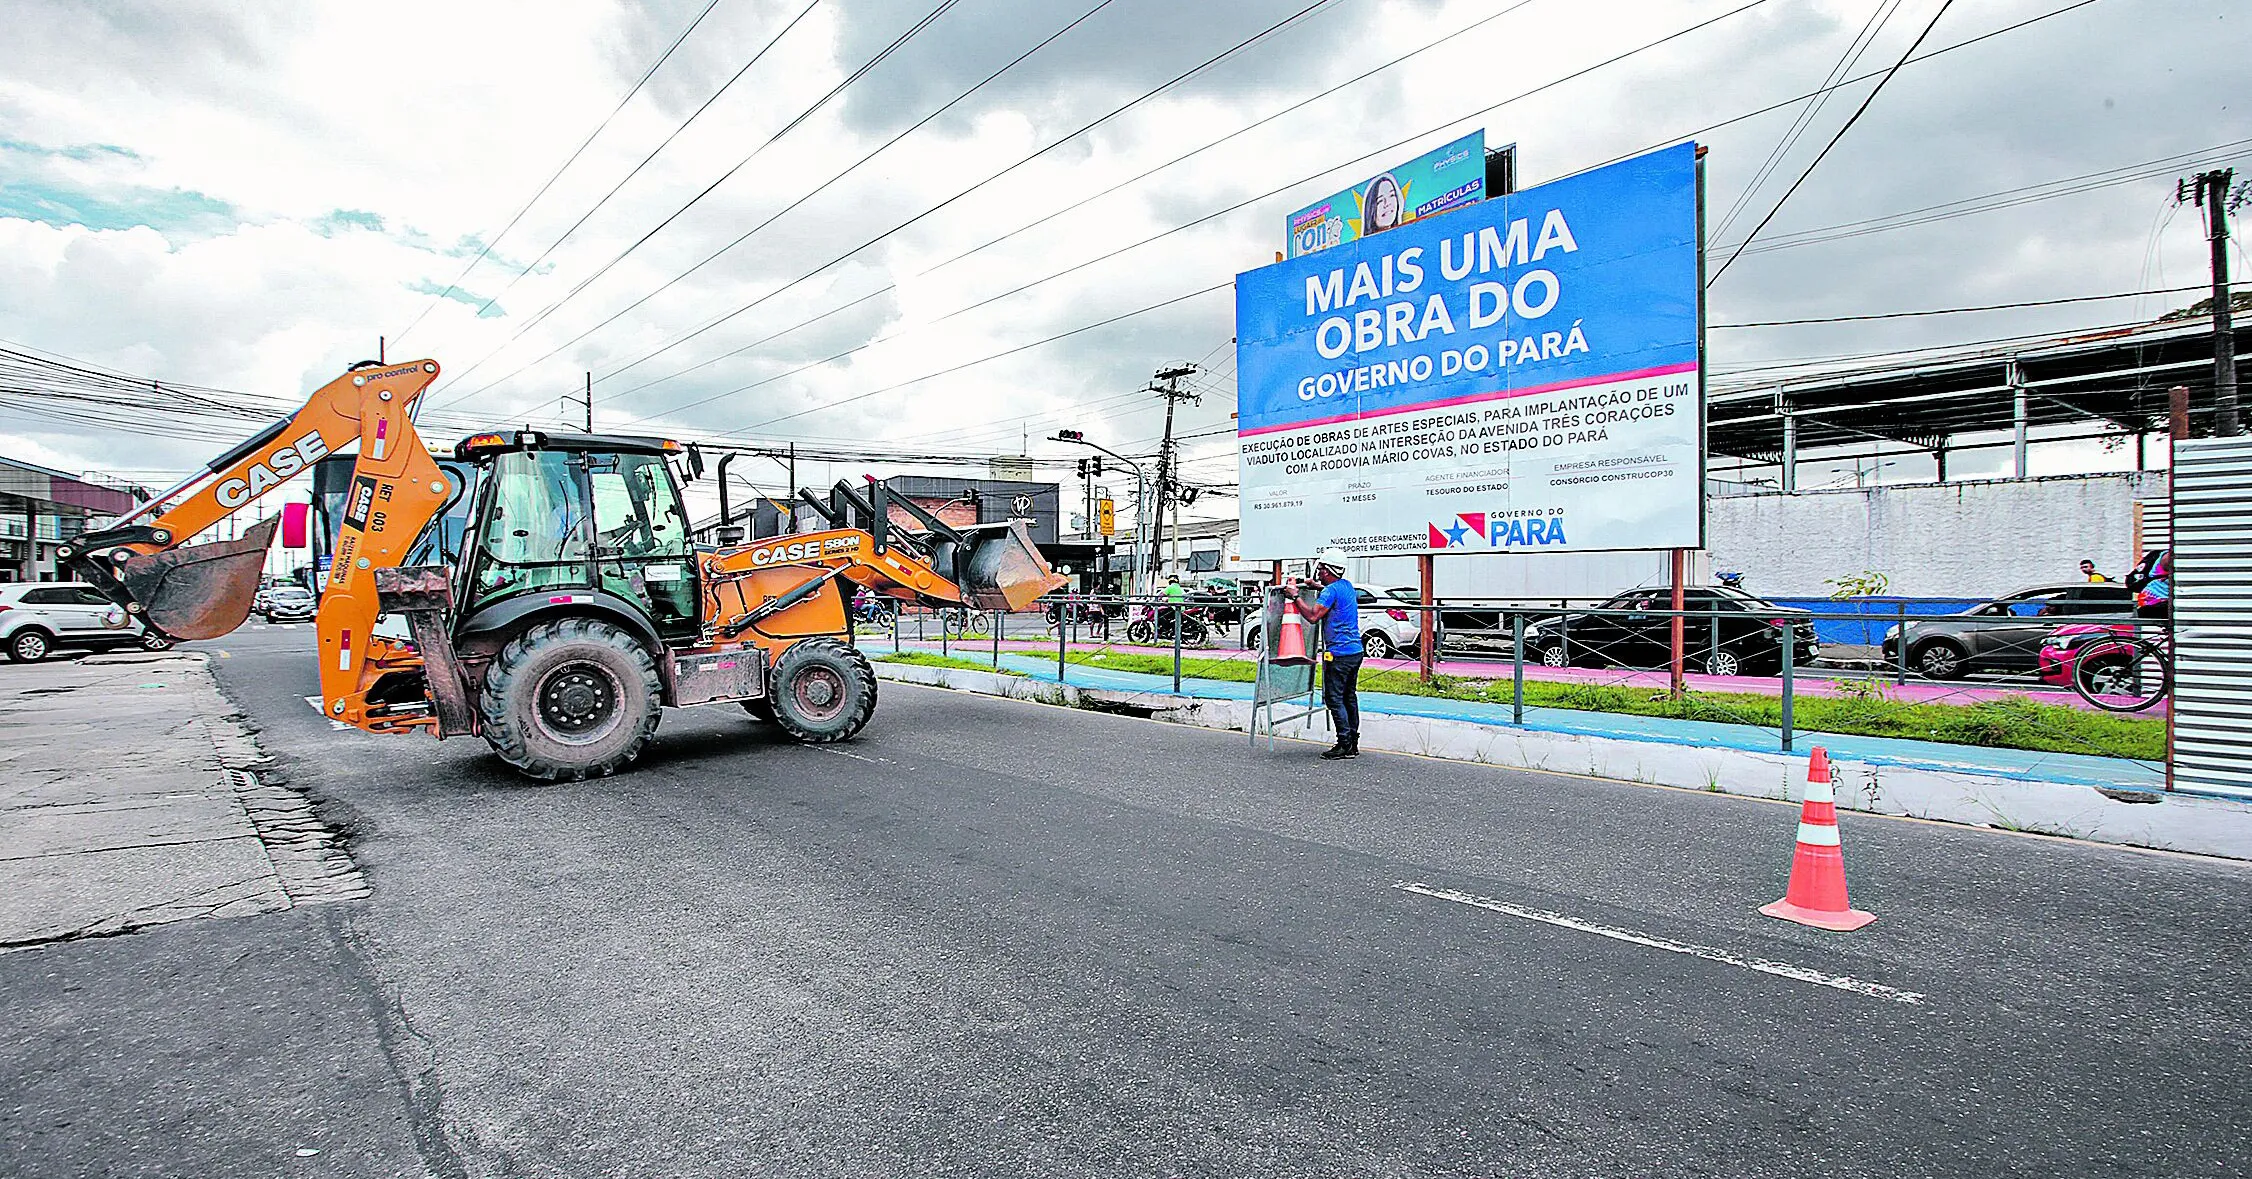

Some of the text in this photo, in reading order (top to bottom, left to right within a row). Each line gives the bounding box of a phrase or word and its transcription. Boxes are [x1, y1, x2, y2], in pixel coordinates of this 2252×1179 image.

[1305, 208, 1579, 316] MAIS UMA
[1315, 269, 1560, 360] OBRA DO
[1297, 318, 1590, 402] GOVERNO DO PARÁ
[366, 365, 418, 383] pro control
[1242, 383, 1689, 454] EXECUÇÃO DE OBRAS DE ARTES ESPECIAIS, PARA IMPLANTAÇÃO DE UM
[1246, 403, 1675, 467] VIADUTO LOCALIZADO NA INTERSEÇÃO DA AVENIDA TRÊS CORAÇÕES
[1285, 426, 1609, 475] COM A RODOVIA MÁRIO COVAS, NO ESTADO DO PARÁ
[215, 429, 329, 508] CASE
[1554, 454, 1668, 472] EMPRESA RESPONSÁVEL
[1425, 468, 1509, 482] AGENTE FINANCIADOR
[1550, 469, 1674, 487] CONSÓRCIO CONSTRUCOP30
[1268, 489, 1288, 497] VALOR
[1347, 482, 1372, 490] PRAZO
[1426, 483, 1509, 496] TESOURO DO ESTADO
[354, 485, 373, 523] CASE
[1351, 494, 1377, 502] MESES
[371, 483, 394, 533] RET 003
[1490, 507, 1564, 519] GOVERNO DO
[1330, 534, 1428, 545] NÚCLEO DE GERENCIAMENTO
[1490, 517, 1567, 547] PARÁ
[823, 536, 860, 549] 580N
[1326, 544, 1368, 553] SPORTE
[1369, 542, 1428, 551] METROPOLITANO
[751, 541, 821, 566] CASE
